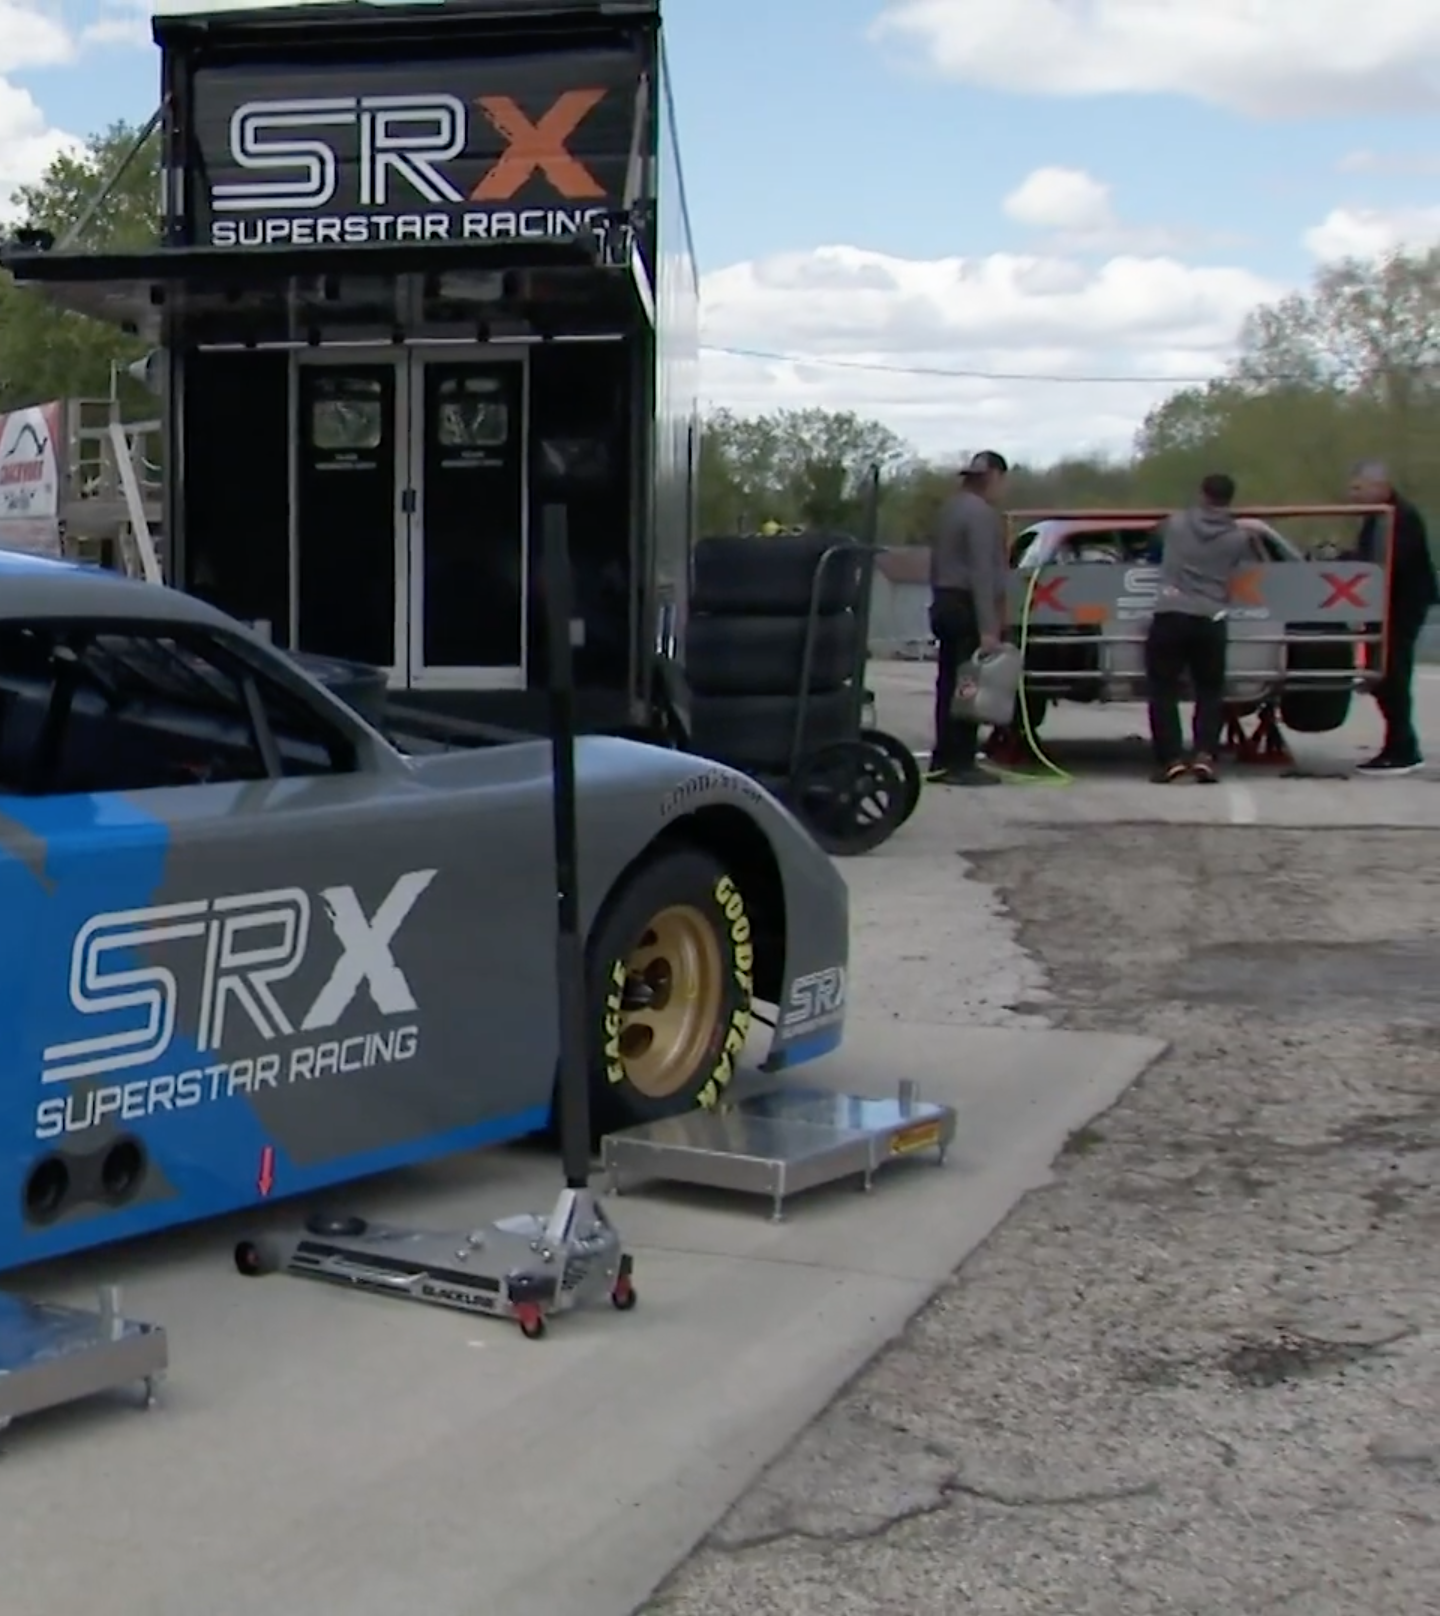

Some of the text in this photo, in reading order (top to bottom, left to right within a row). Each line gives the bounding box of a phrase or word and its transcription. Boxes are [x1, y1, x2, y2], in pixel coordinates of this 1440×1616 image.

[212, 88, 607, 210] SRX
[212, 213, 449, 247] SUPERSTAR
[41, 868, 439, 1084] SRX
[35, 1025, 419, 1138] SUPERSTAR RACING
